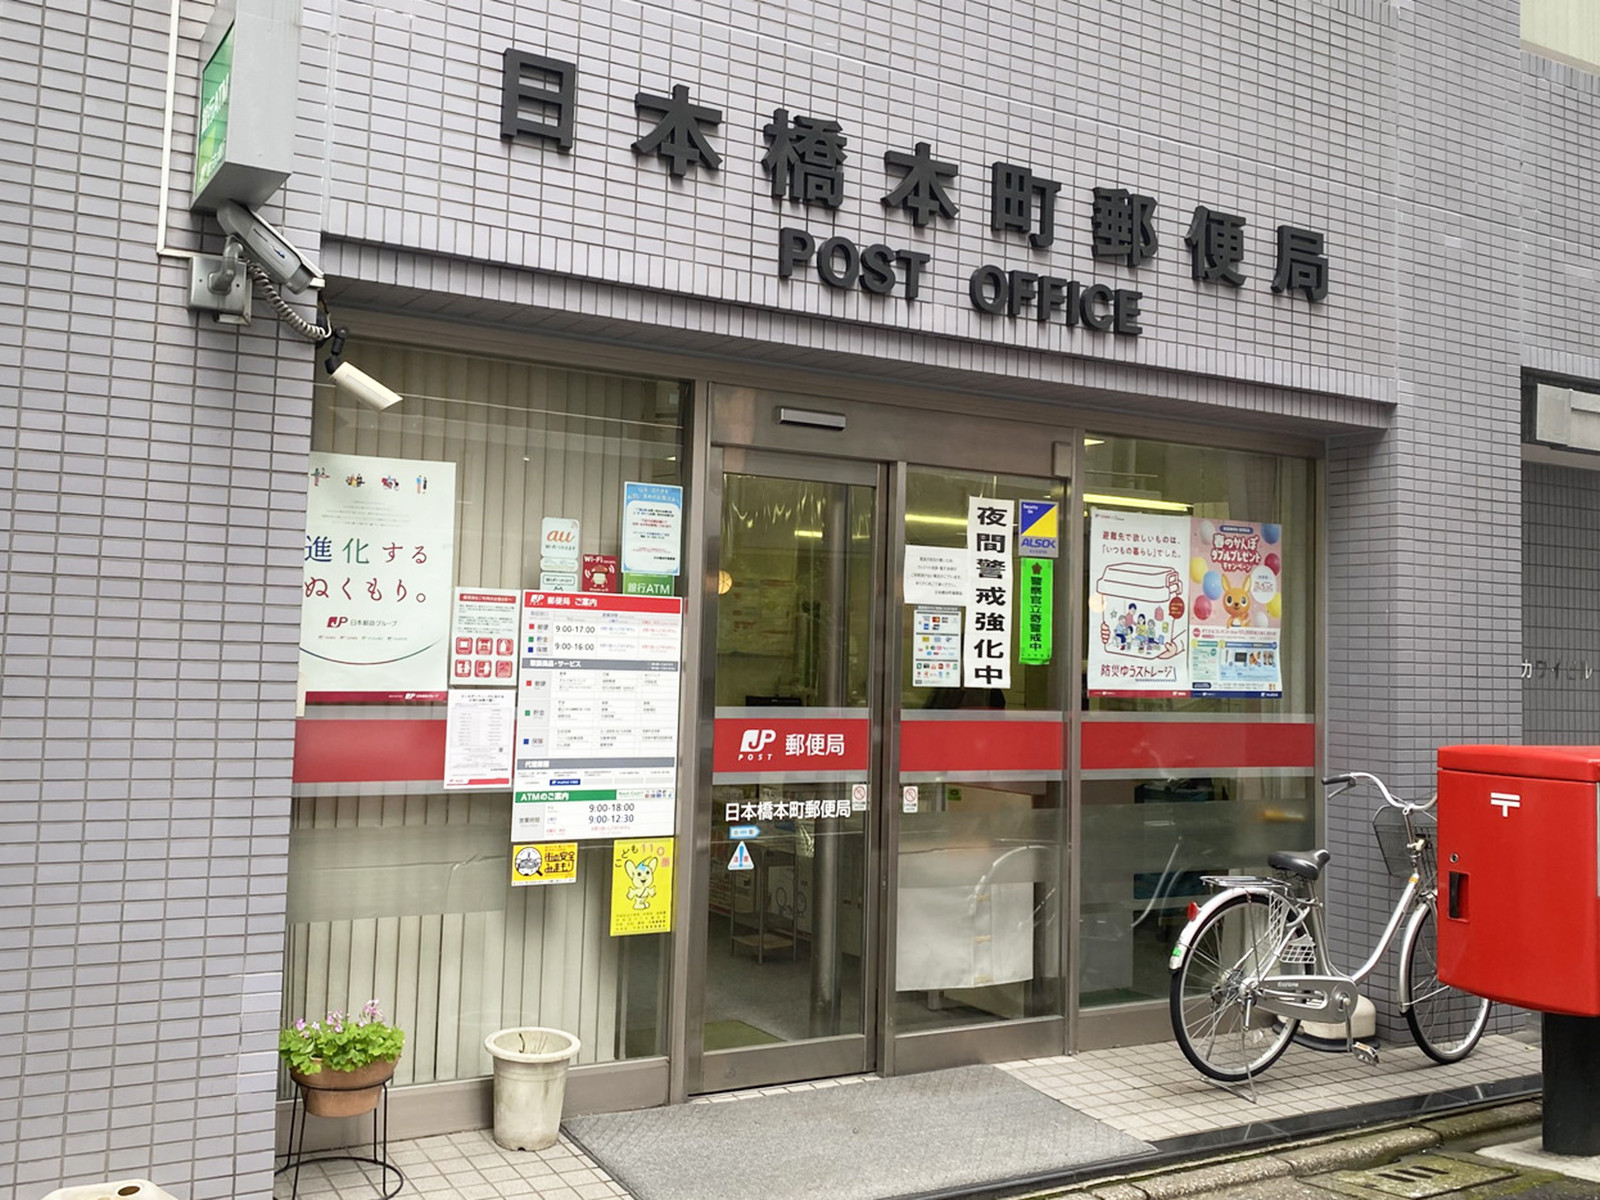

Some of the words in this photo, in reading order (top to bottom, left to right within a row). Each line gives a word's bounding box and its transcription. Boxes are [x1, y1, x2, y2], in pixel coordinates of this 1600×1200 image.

[501, 48, 1328, 301] 日本橋本町郵便局
[779, 227, 930, 300] POST
[969, 264, 1143, 335] OFFICE
[547, 530, 575, 542] au
[1102, 530, 1180, 545] 避難先で欲しいものは、
[304, 535, 427, 564] 進化する
[1021, 538, 1056, 549] ALSOK
[1102, 544, 1181, 558] 「いつもの暮らし」でした。
[1211, 548, 1261, 563] ダブルプレゼント
[304, 577, 426, 603] ぬくもり。
[627, 582, 670, 595] 銀行ATM
[974, 506, 1008, 685] 夜間警戒強化中
[574, 597, 598, 607] ご案内
[1100, 664, 1174, 678] 防災ゆうストレージ
[740, 729, 776, 752] JP
[785, 734, 845, 756] 郵便局
[520, 792, 570, 801] ATMのご案内
[589, 803, 635, 812] 9:00-18:00
[725, 800, 851, 821] 日本橋本町郵便局
[588, 814, 635, 824] 9:00-12:30
